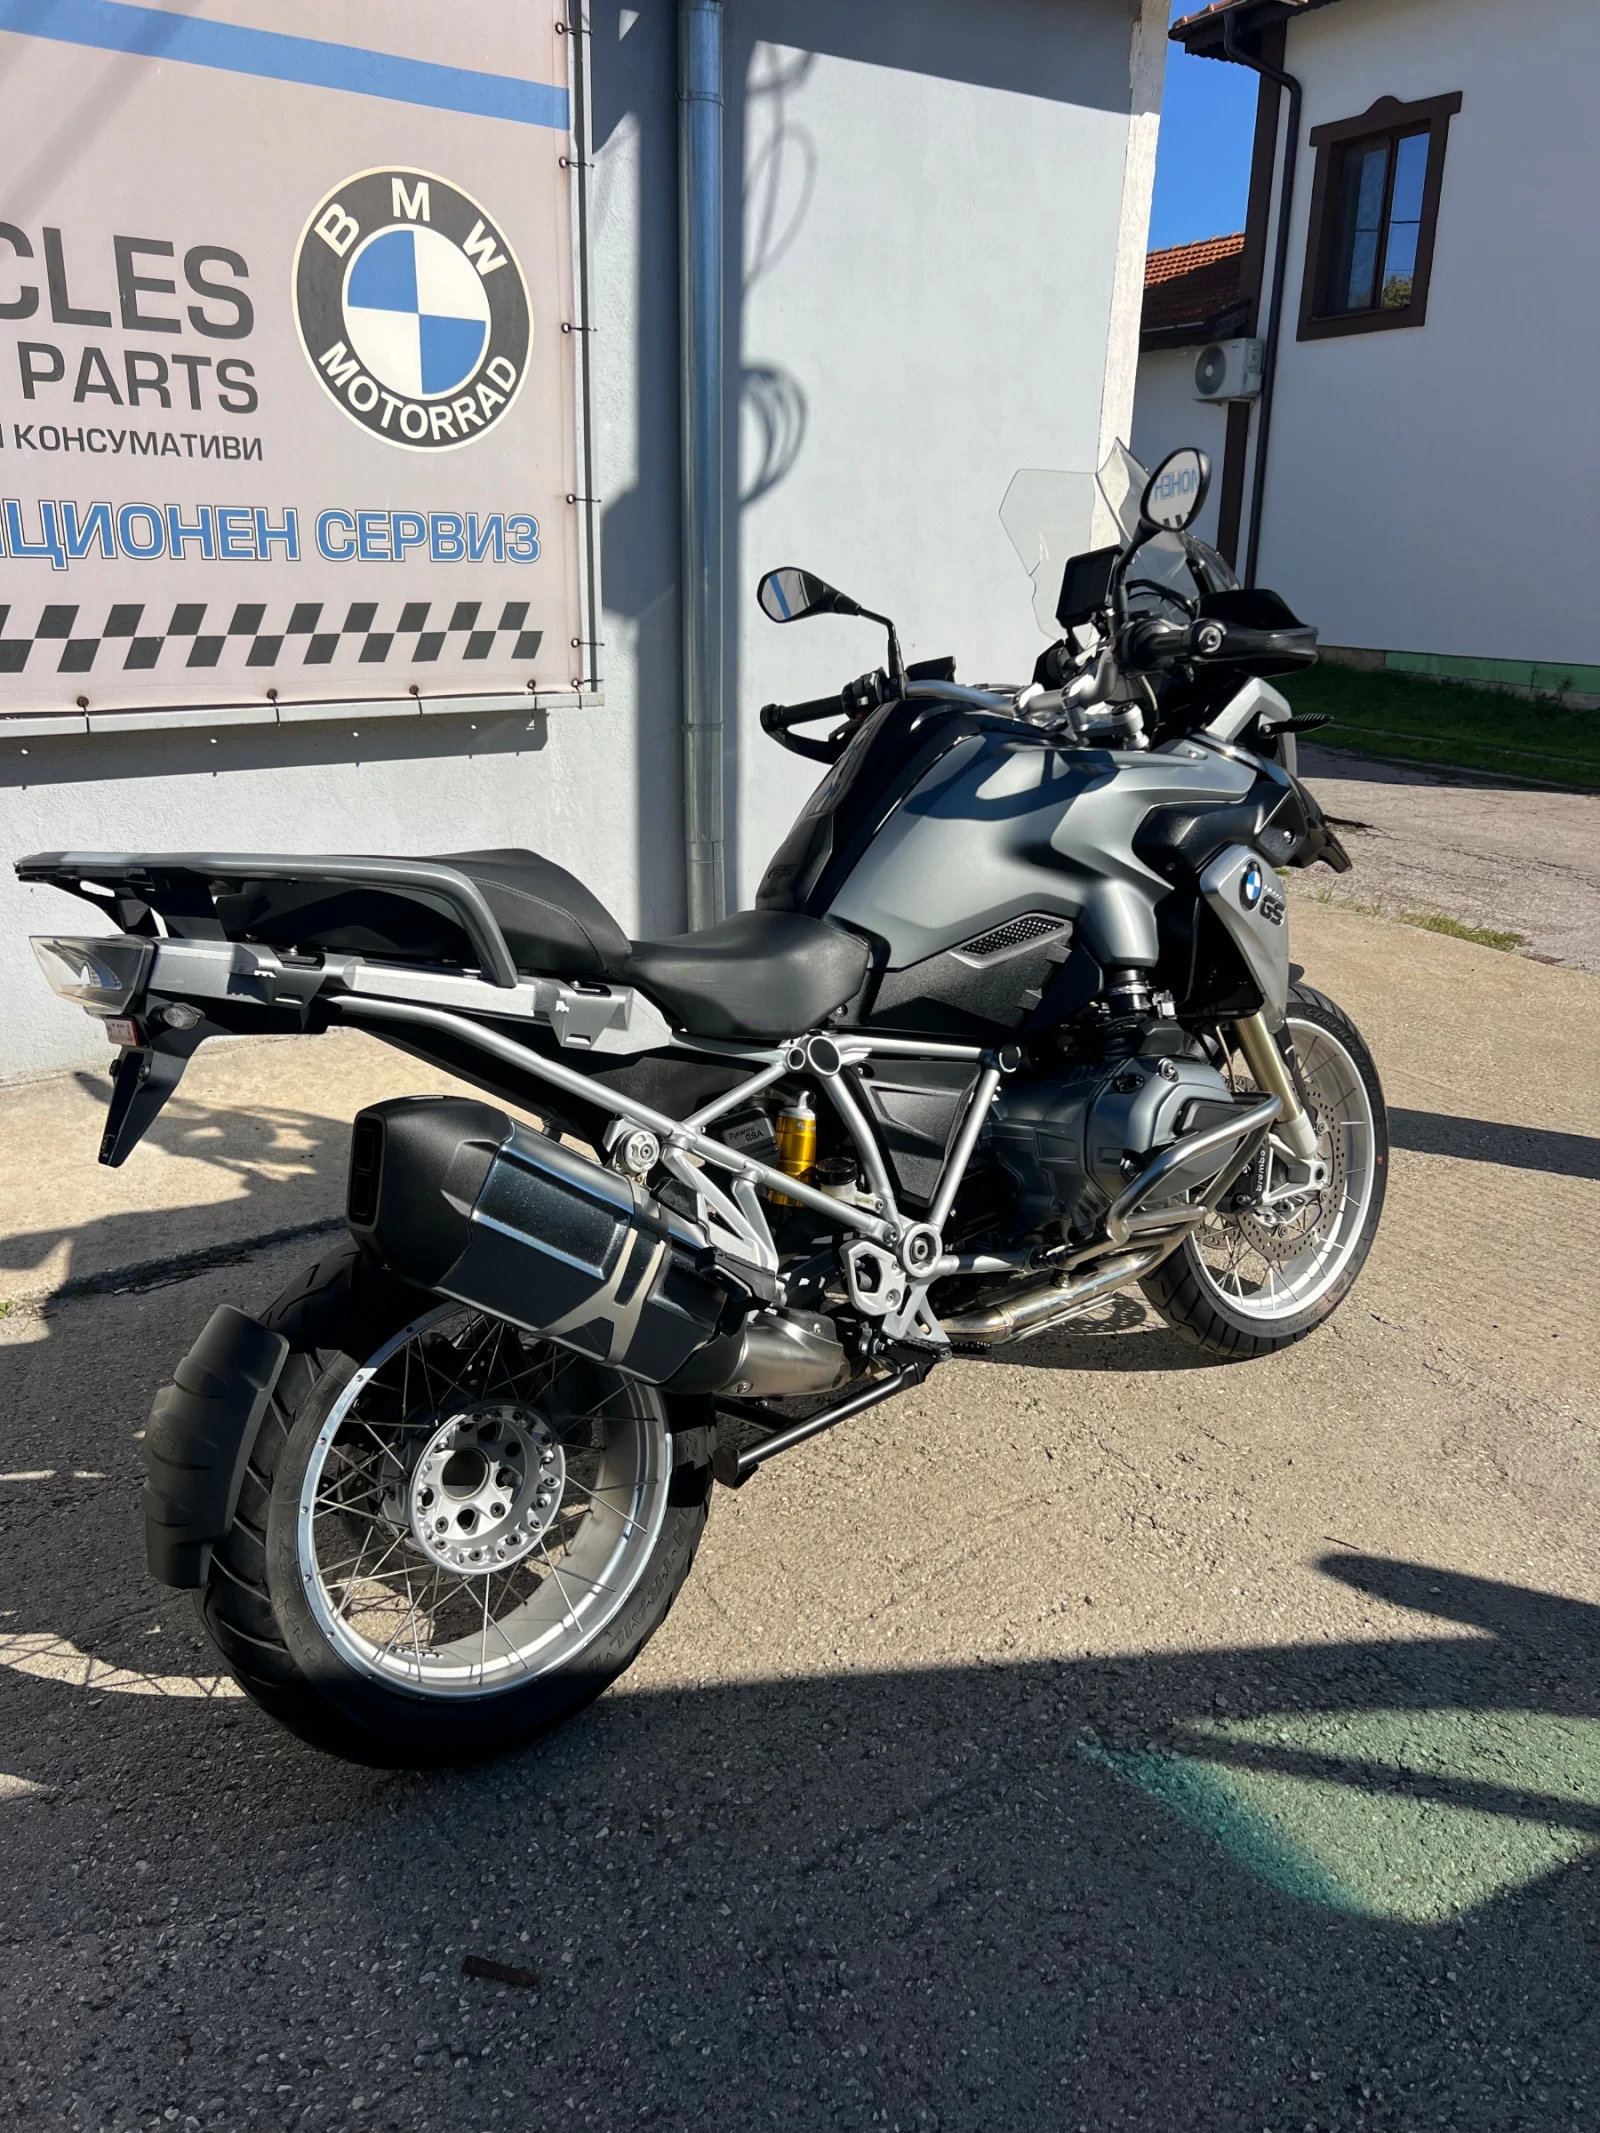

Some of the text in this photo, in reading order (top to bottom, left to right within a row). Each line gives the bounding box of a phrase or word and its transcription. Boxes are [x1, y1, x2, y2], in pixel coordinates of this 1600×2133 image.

[314, 177, 508, 277] BMW
[17, 341, 259, 414] PARTS
[318, 340, 518, 441] MOTORRAD
[14, 424, 263, 461] КОНСУМАТИВИ
[0, 498, 542, 571] ЦИОНЕН СЕРВИЗ
[745, 1130, 764, 1141] ESA
[1255, 1150, 1266, 1191] brembo
